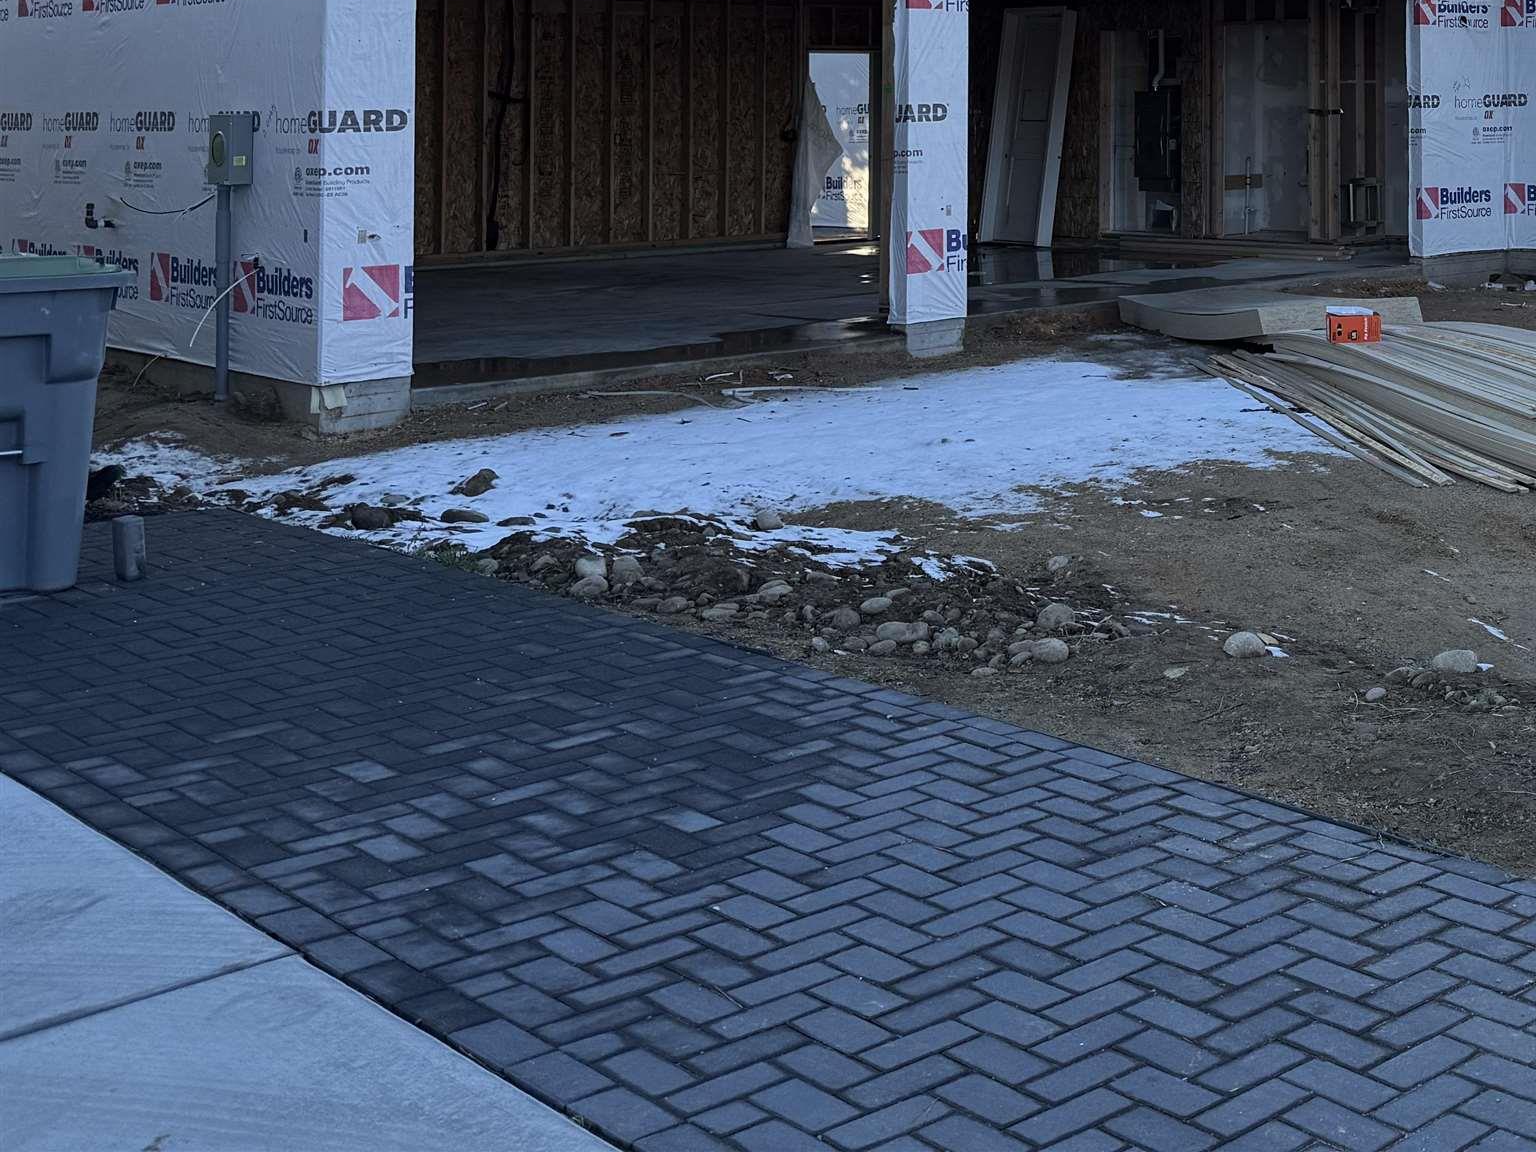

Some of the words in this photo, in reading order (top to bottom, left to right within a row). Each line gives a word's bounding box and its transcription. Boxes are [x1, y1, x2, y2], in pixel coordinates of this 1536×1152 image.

[1454, 93, 1529, 109] homeGUARD
[1440, 186, 1491, 205] Builders
[1440, 206, 1492, 220] FirstSource
[256, 265, 313, 299] Builders
